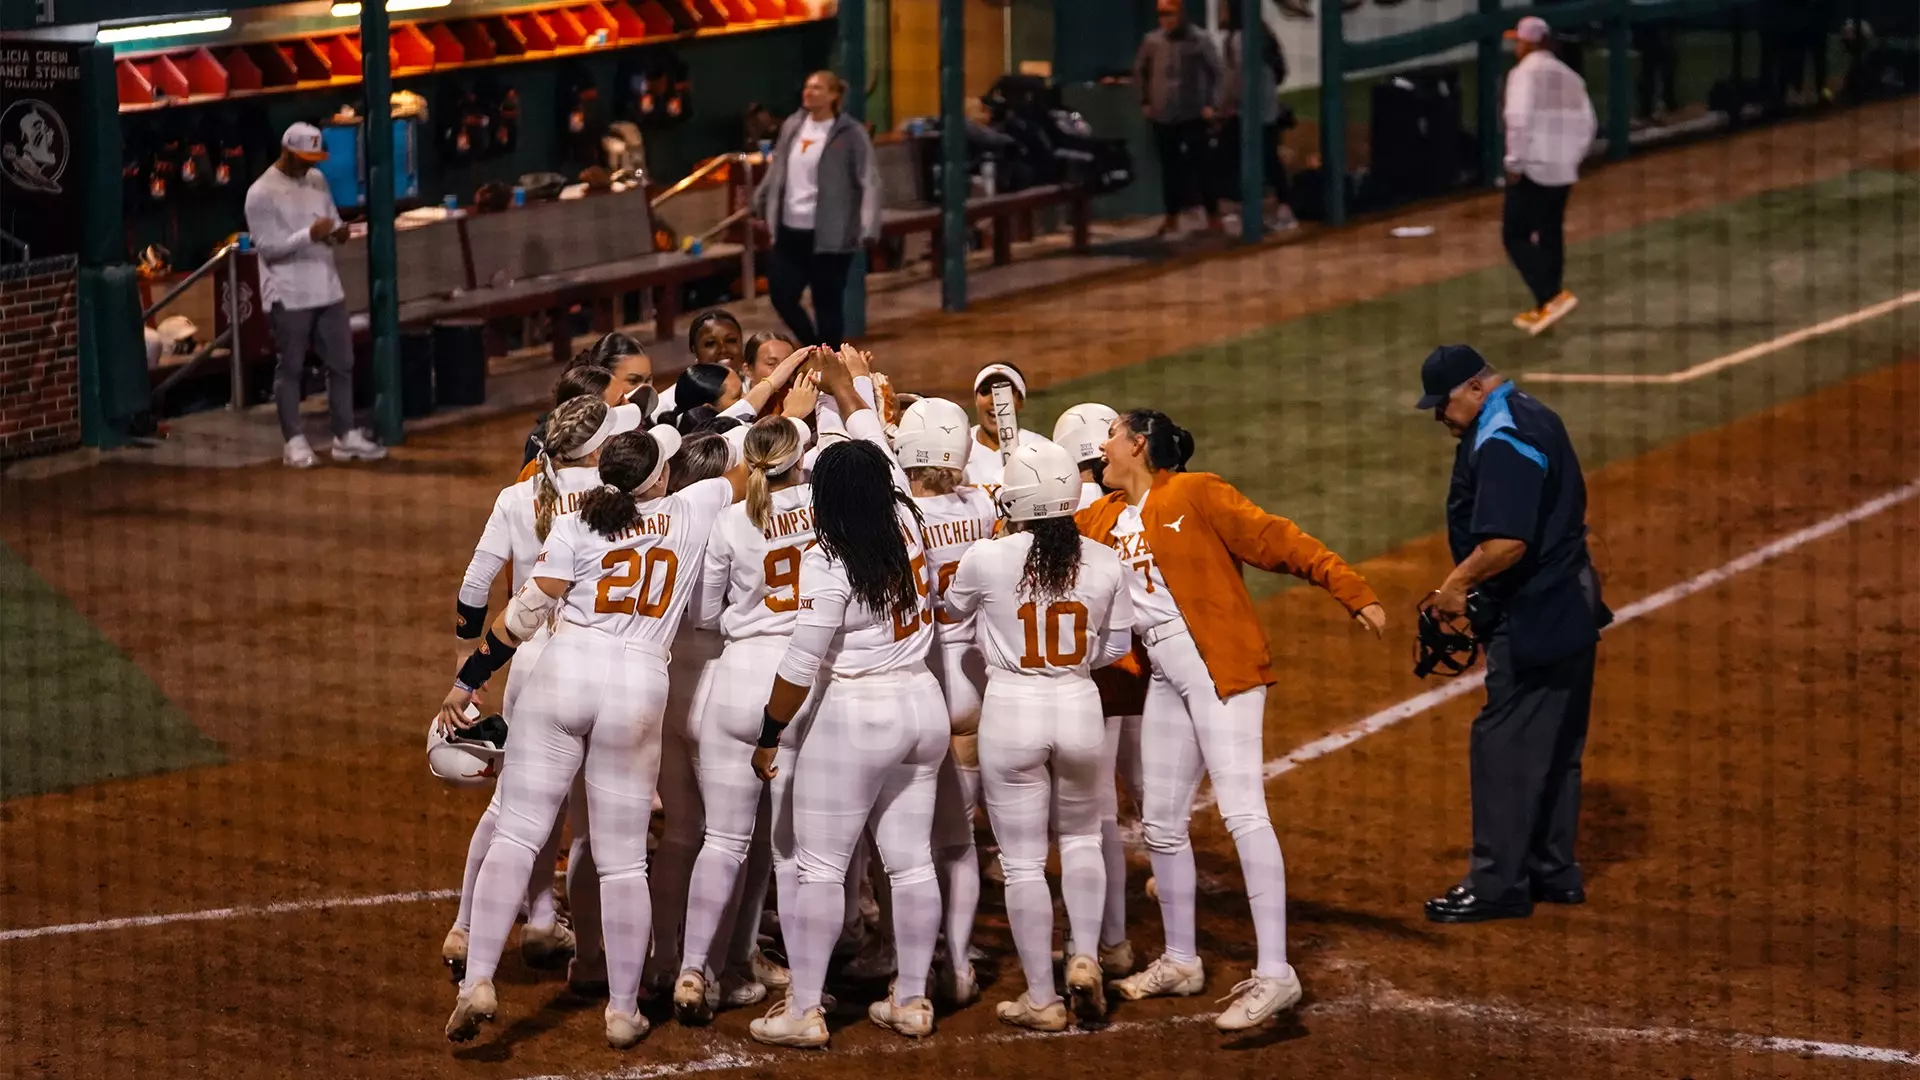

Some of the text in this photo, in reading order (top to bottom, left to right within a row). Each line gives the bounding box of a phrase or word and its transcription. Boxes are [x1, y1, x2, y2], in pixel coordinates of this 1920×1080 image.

[35, 50, 69, 64] CREW
[4, 79, 56, 89] DUGOUT
[942, 452, 951, 462] 9
[1059, 501, 1070, 512] 10
[921, 518, 984, 551] MITCHELL
[594, 546, 679, 619] 20
[763, 538, 817, 613] 9
[1016, 600, 1089, 669] 10
